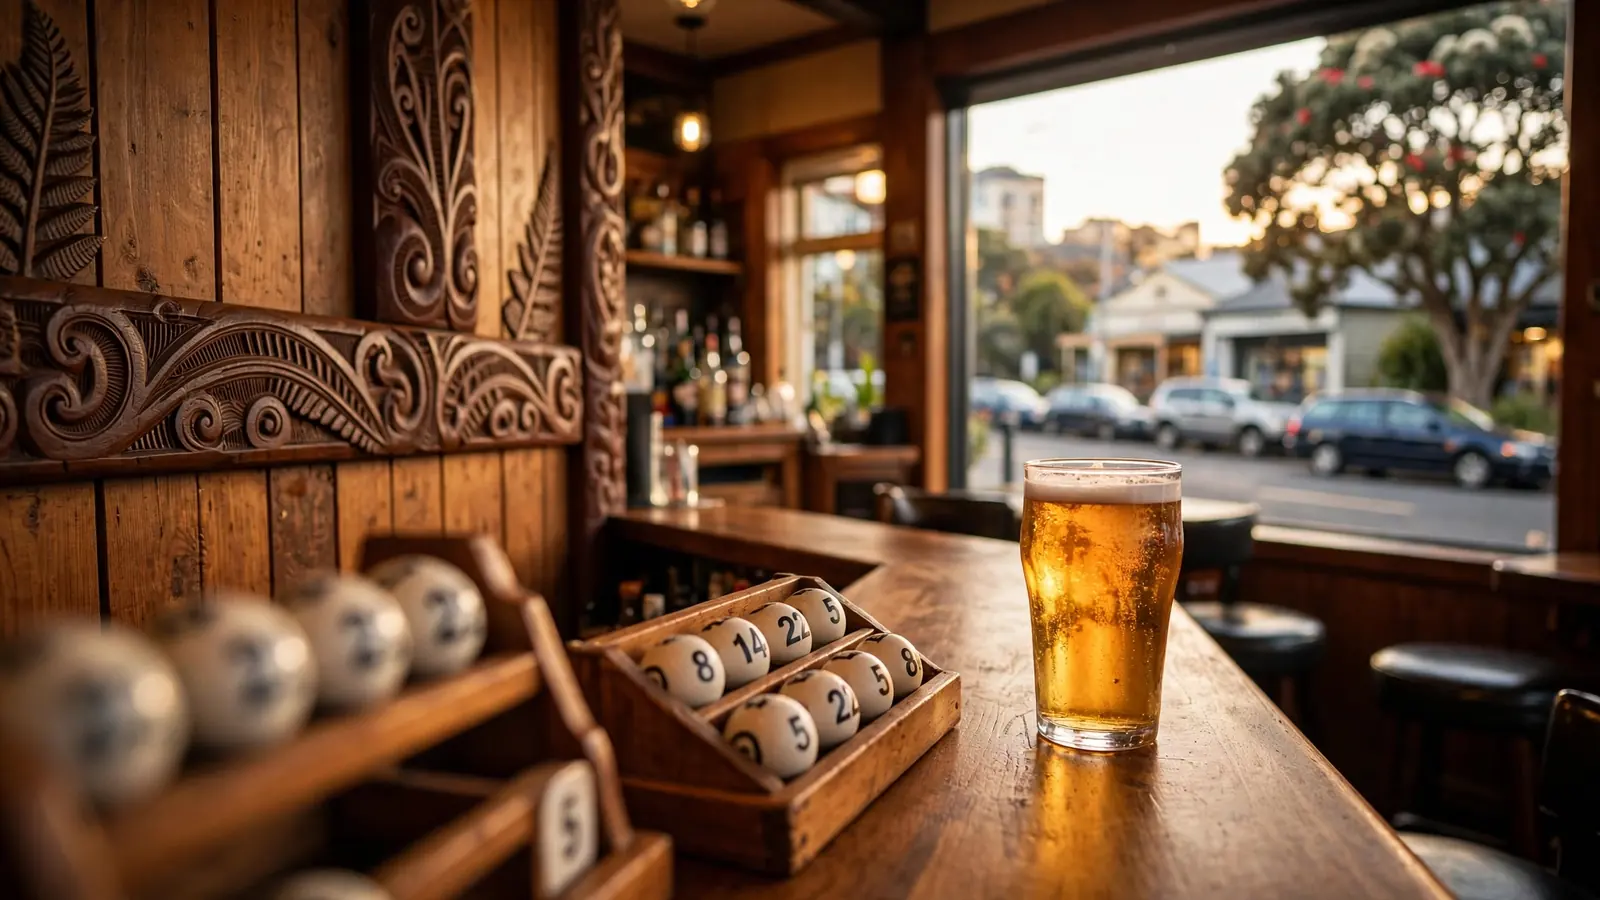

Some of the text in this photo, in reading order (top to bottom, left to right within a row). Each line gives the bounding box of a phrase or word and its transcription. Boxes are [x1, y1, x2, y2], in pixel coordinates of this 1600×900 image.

[823, 597, 841, 625] 5
[777, 611, 811, 647] 22
[732, 628, 768, 664] 14
[900, 647, 918, 677] 8
[692, 651, 715, 682] 8
[870, 664, 890, 696] 5
[787, 714, 811, 751] 5
